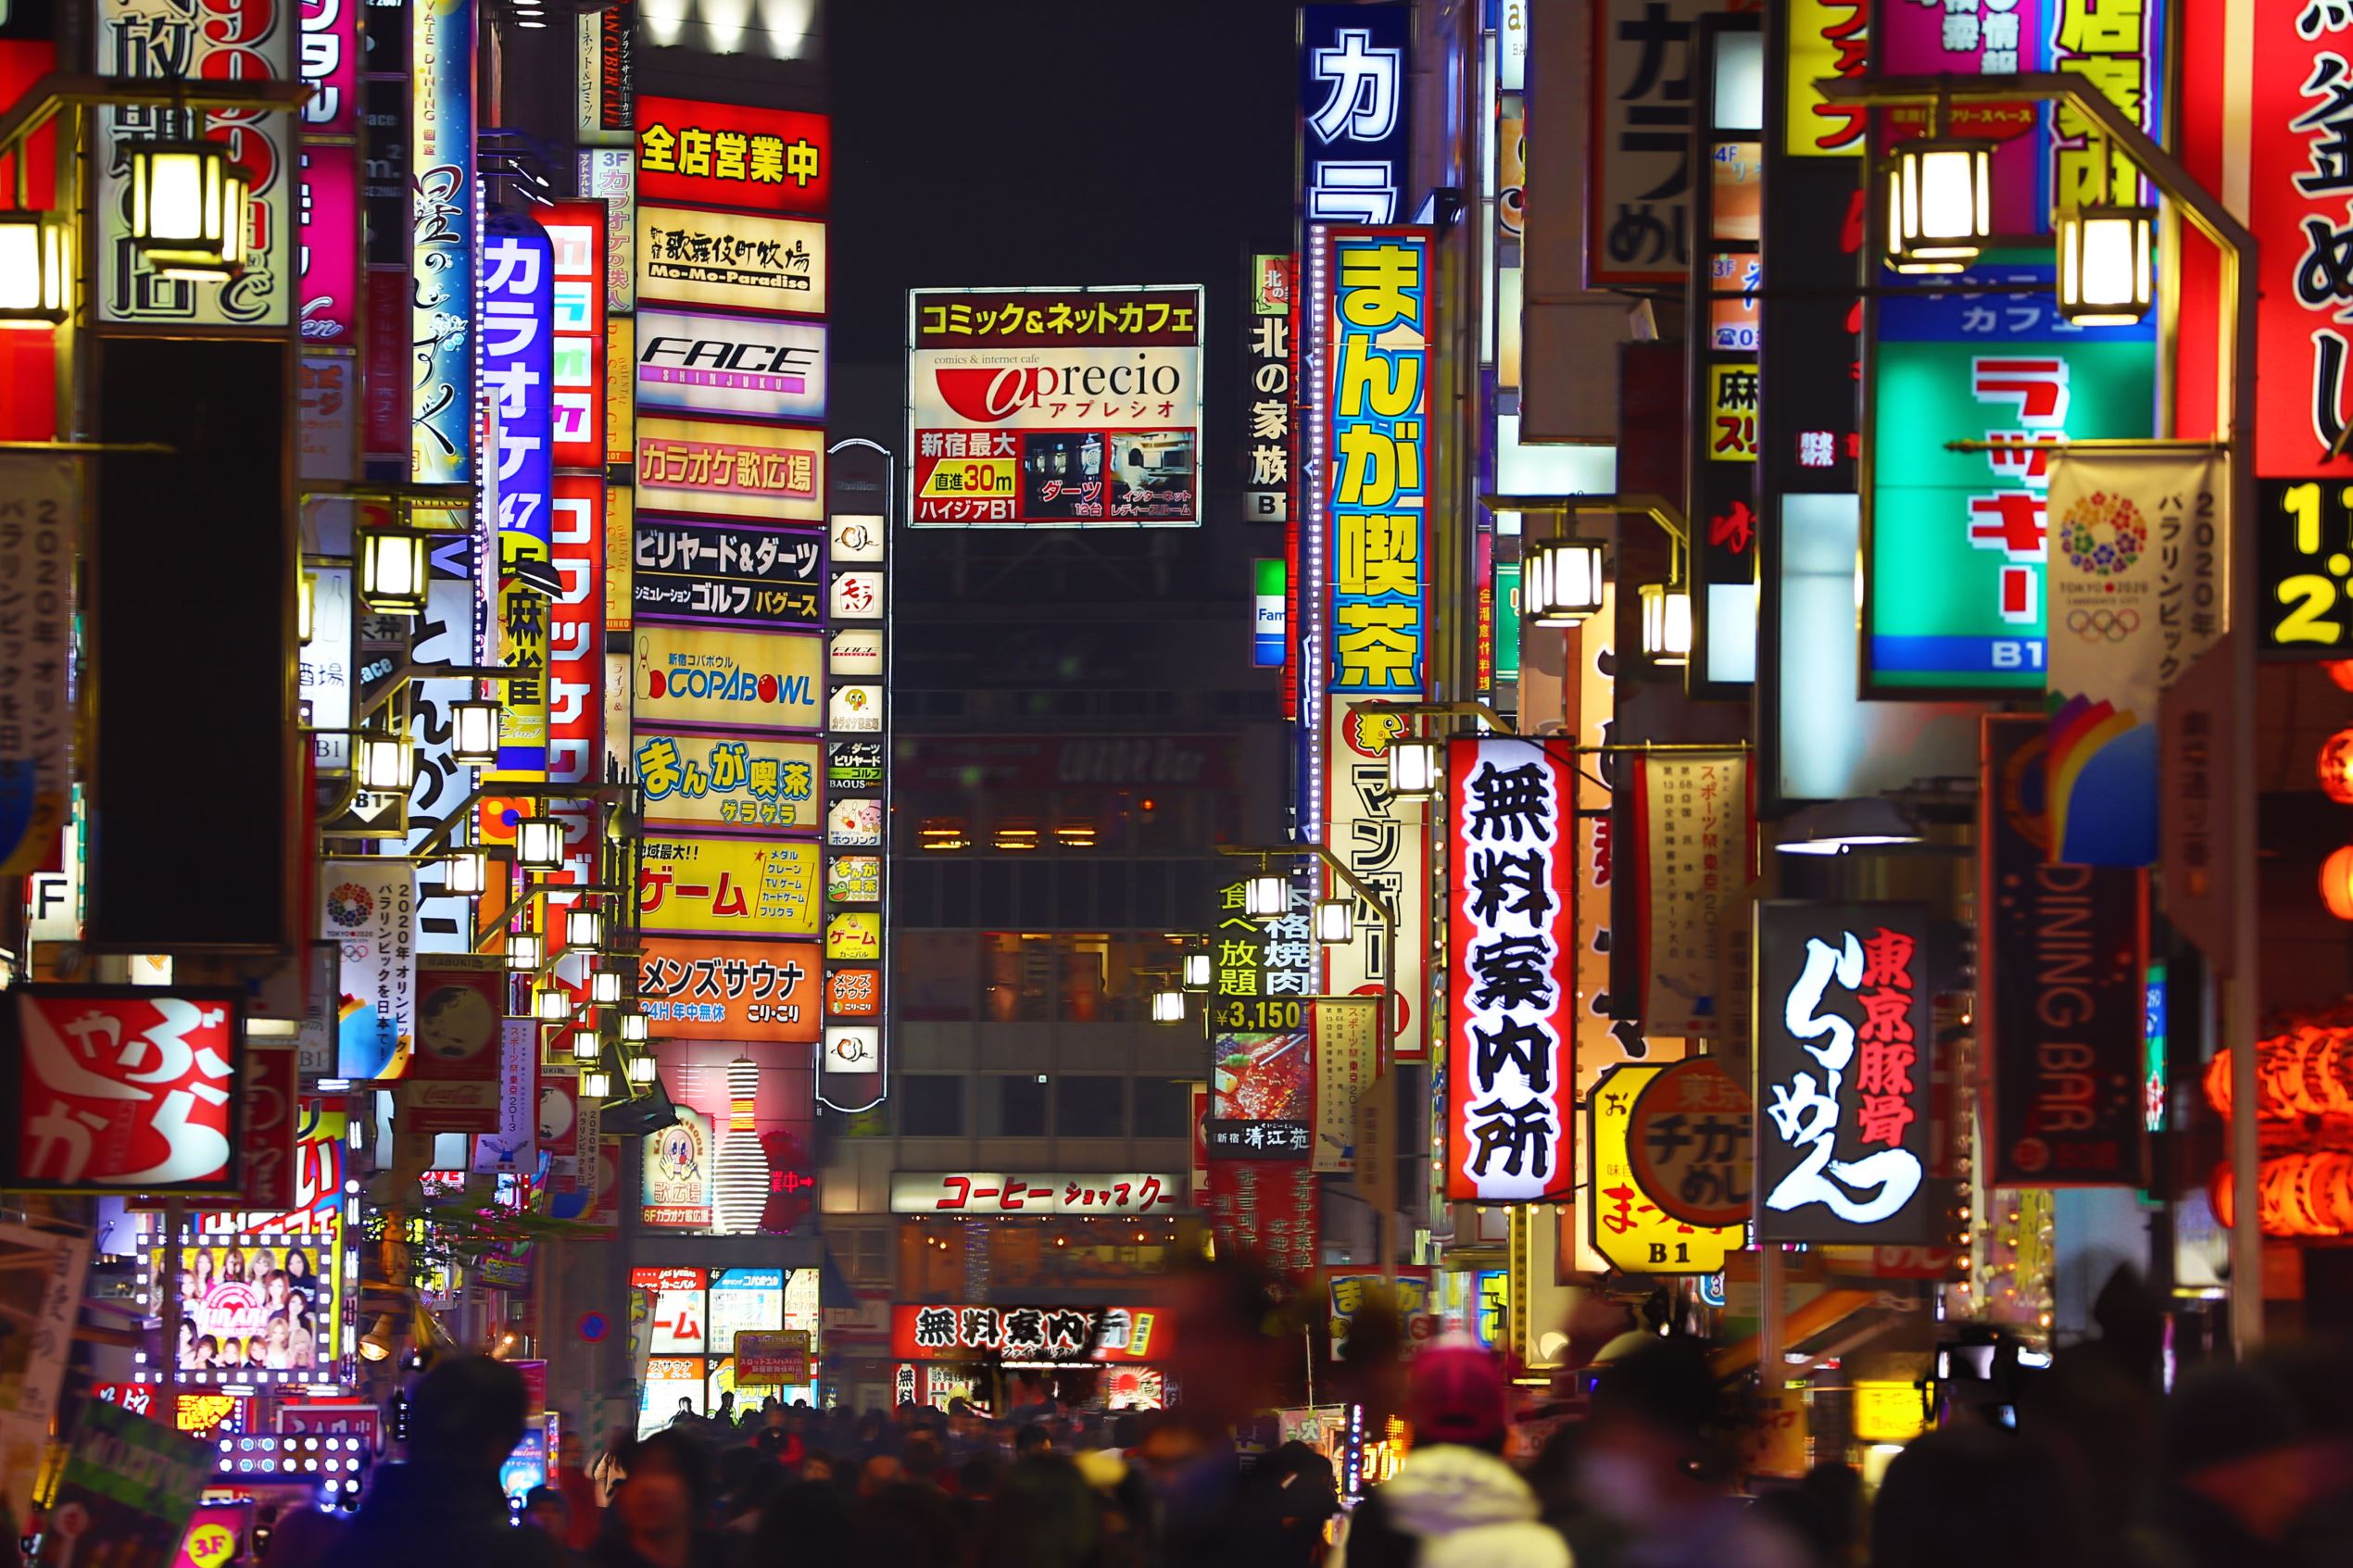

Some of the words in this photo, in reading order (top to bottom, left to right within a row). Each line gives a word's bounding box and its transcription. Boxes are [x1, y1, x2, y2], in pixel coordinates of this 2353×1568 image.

[603, 152, 629, 166] 3F
[640, 122, 819, 188] 全店営業中
[665, 229, 811, 273] 歌舞伎町牧場
[649, 263, 811, 291] Mo-Mo-Paradise
[923, 302, 1194, 335] コミック&ネットカフェ
[483, 238, 541, 481] カラオケ
[640, 336, 820, 375] FACE
[934, 356, 967, 364] comics
[970, 355, 978, 364] &
[982, 355, 1017, 364] internet
[1020, 355, 1039, 364] cafe
[662, 369, 782, 391] SHINJUKU
[984, 353, 1181, 415] aprecio
[1049, 400, 1175, 419] アプレシオ
[1252, 318, 1289, 485] 北の家族
[920, 433, 1016, 458] 新宿最大
[642, 445, 812, 492] カラオケ歌広場
[1338, 245, 1419, 686] まんが喫茶
[935, 464, 1013, 492] 直進30m
[1040, 480, 1102, 502] ダーツ
[1122, 490, 1192, 502] インターネット
[919, 500, 1016, 521] ハイジアB1
[1074, 503, 1102, 517] 12台
[1111, 504, 1192, 517] レディースルーム
[635, 530, 819, 578] ビリヤード&ダーツ
[691, 583, 751, 614] ゴルフ
[755, 591, 818, 618] バグース
[506, 588, 543, 707] 麻雀
[1992, 642, 2043, 668] B1
[668, 653, 734, 669] 新宿コパボウル
[667, 661, 815, 706] COPABOWL
[316, 740, 340, 758] B1
[851, 743, 880, 755] ダーツ
[635, 736, 812, 801] まんが喫茶
[834, 755, 881, 767] ビリヤード
[851, 768, 881, 779] ゴルフ
[720, 802, 797, 827] ゲラゲラ
[832, 835, 878, 846] ボウリング
[770, 849, 799, 861] メダル
[767, 863, 802, 875] クレーン
[836, 861, 877, 879] まんが
[640, 864, 750, 919] ゲーム
[761, 891, 805, 905] カードゲーム
[849, 880, 876, 894] 喫茶
[760, 906, 795, 918] プリクラ
[829, 929, 876, 946] ゲーム
[2040, 863, 2095, 1028] DINING
[641, 957, 804, 1001] メンズサウナ
[834, 973, 872, 986] メンズ
[1470, 760, 1554, 1178] 無料案内所
[834, 986, 872, 999] サウナ
[672, 1002, 725, 1023] 年中無休
[1216, 1001, 1301, 1030] ¥3,150
[1856, 926, 1917, 1148] 東京豚骨
[2040, 1042, 2095, 1132] BAR
[1217, 1133, 1239, 1144] 新宿
[654, 1182, 702, 1204] 歌広場
[936, 1176, 1054, 1210] コーヒー
[1648, 1242, 1691, 1264] B1
[195, 1536, 225, 1557] 3F
